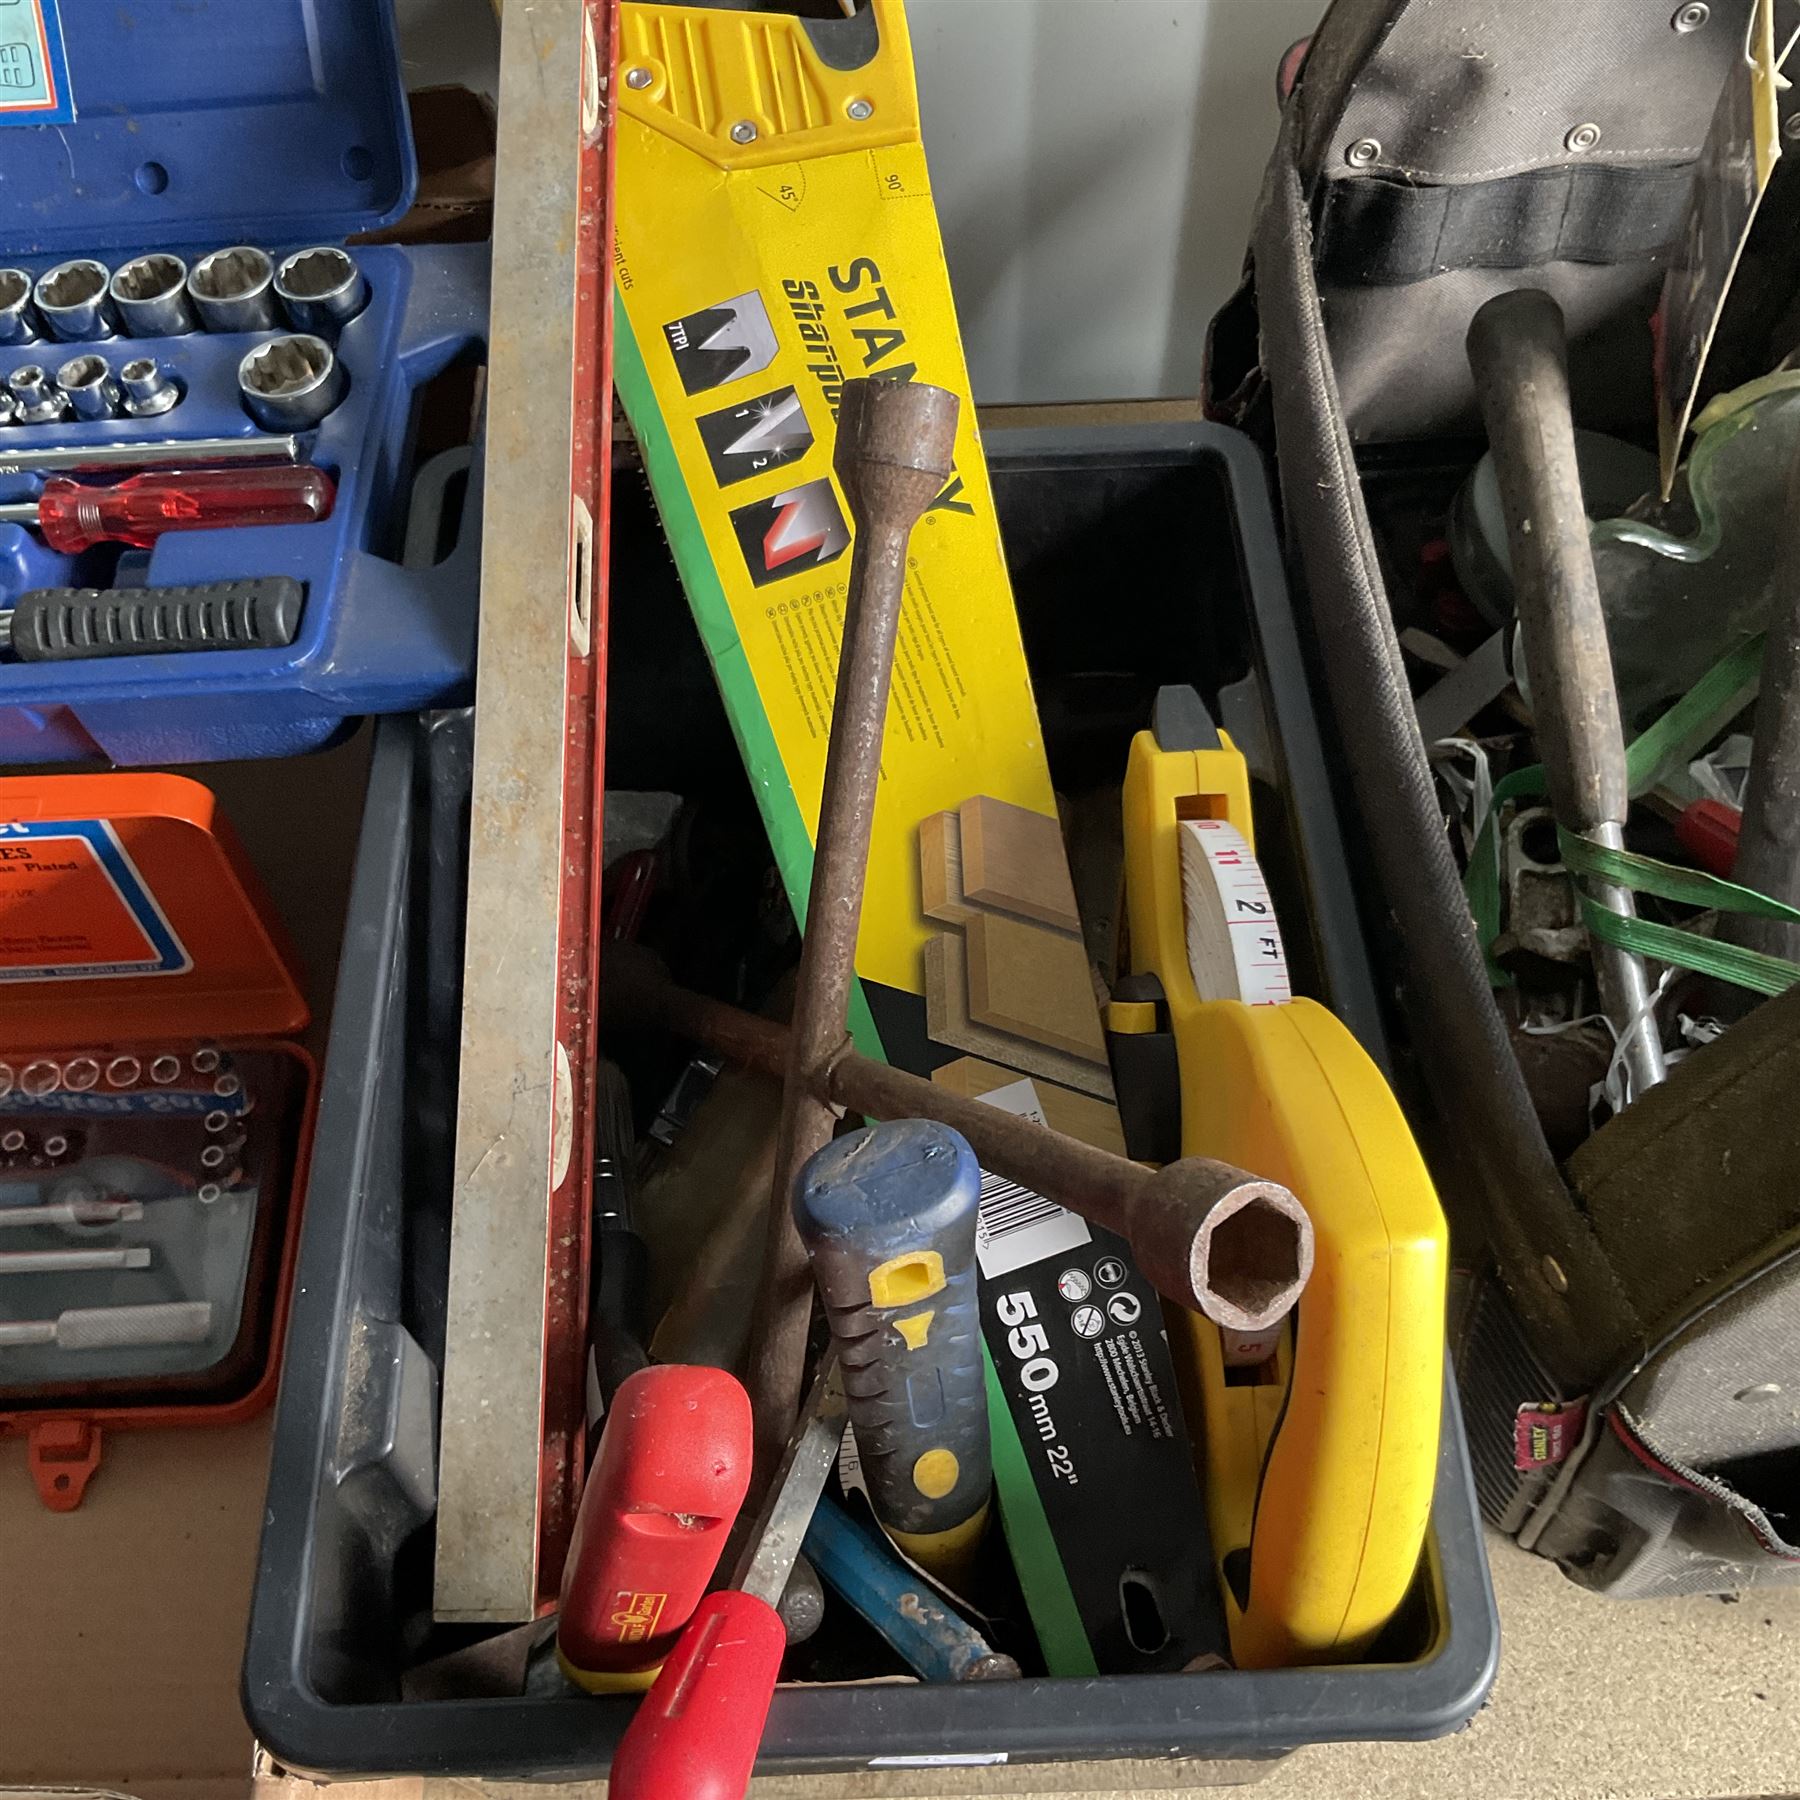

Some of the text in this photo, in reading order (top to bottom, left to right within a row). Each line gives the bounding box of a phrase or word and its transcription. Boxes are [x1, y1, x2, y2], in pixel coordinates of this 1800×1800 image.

[780, 184, 799, 202] 45°
[885, 174, 905, 192] 90°
[619, 267, 634, 290] cuts
[668, 321, 690, 351] 7TPI
[828, 257, 975, 516] STAY
[735, 408, 750, 419] 1
[753, 456, 767, 469] 2
[1214, 849, 1242, 865] 11
[1236, 899, 1279, 960] 2 FT
[1130, 1338, 1145, 1358] 2013
[1136, 1357, 1155, 1385] Stanley
[1532, 1424, 1547, 1460] STANLEY
[1046, 1445, 1079, 1485] 22"
